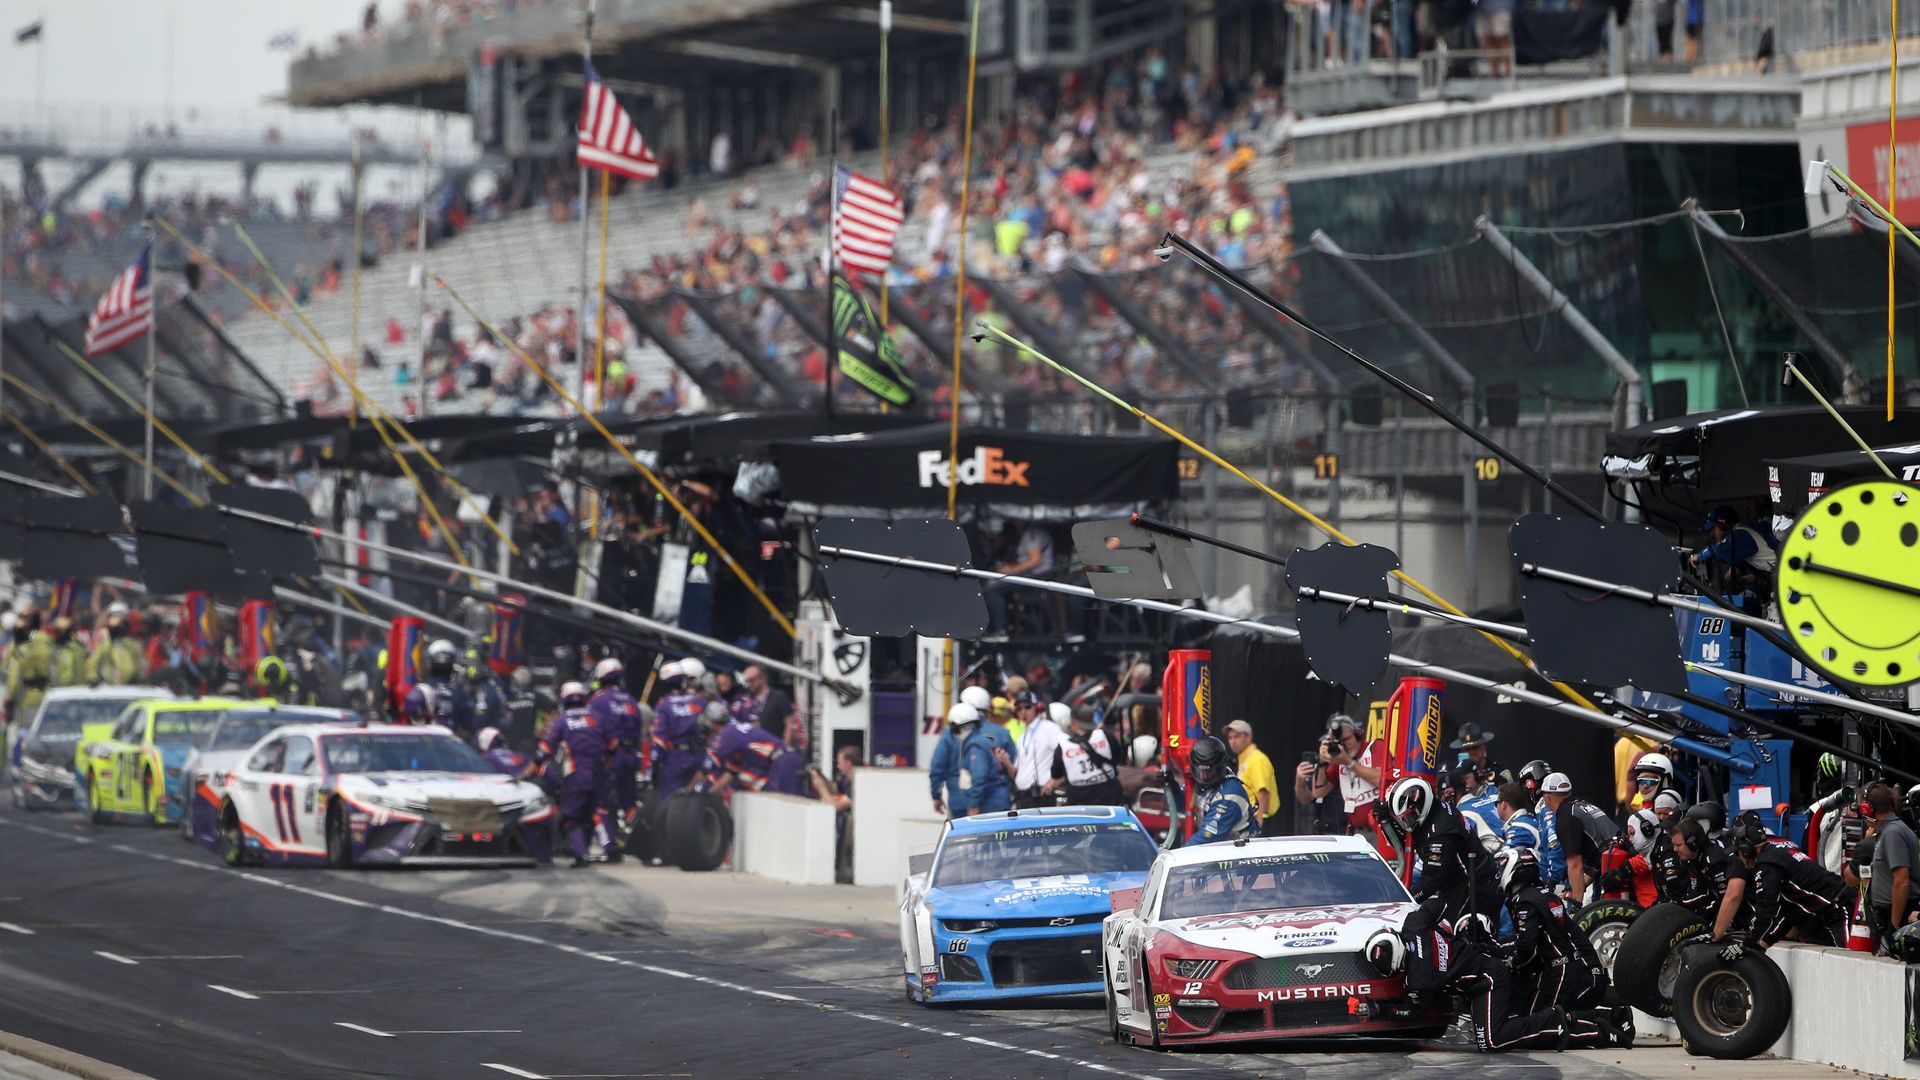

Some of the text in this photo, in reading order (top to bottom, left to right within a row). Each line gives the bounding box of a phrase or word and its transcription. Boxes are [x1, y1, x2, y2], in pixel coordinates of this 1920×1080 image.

[918, 447, 1030, 487] FedEx
[1178, 459, 1198, 478] 12
[1314, 455, 1338, 477] 11
[1475, 458, 1498, 480] 10
[1699, 617, 1724, 636] 88
[1200, 665, 1211, 734] SUNOCO
[1424, 694, 1441, 769] SUNOCO
[1169, 735, 1179, 747] 2
[1393, 768, 1400, 778] 2
[270, 783, 302, 844] 11
[1013, 827, 1079, 836] MONSTER
[1238, 856, 1310, 865] MONSTER
[993, 886, 1110, 903] Nationwide
[1251, 914, 1339, 927] NATIONAL
[1274, 930, 1341, 941] PENNZOIL
[1293, 939, 1327, 949] Ford
[948, 938, 971, 954] 88
[1183, 982, 1203, 995] 12
[1258, 984, 1371, 1002] MUSTANG
